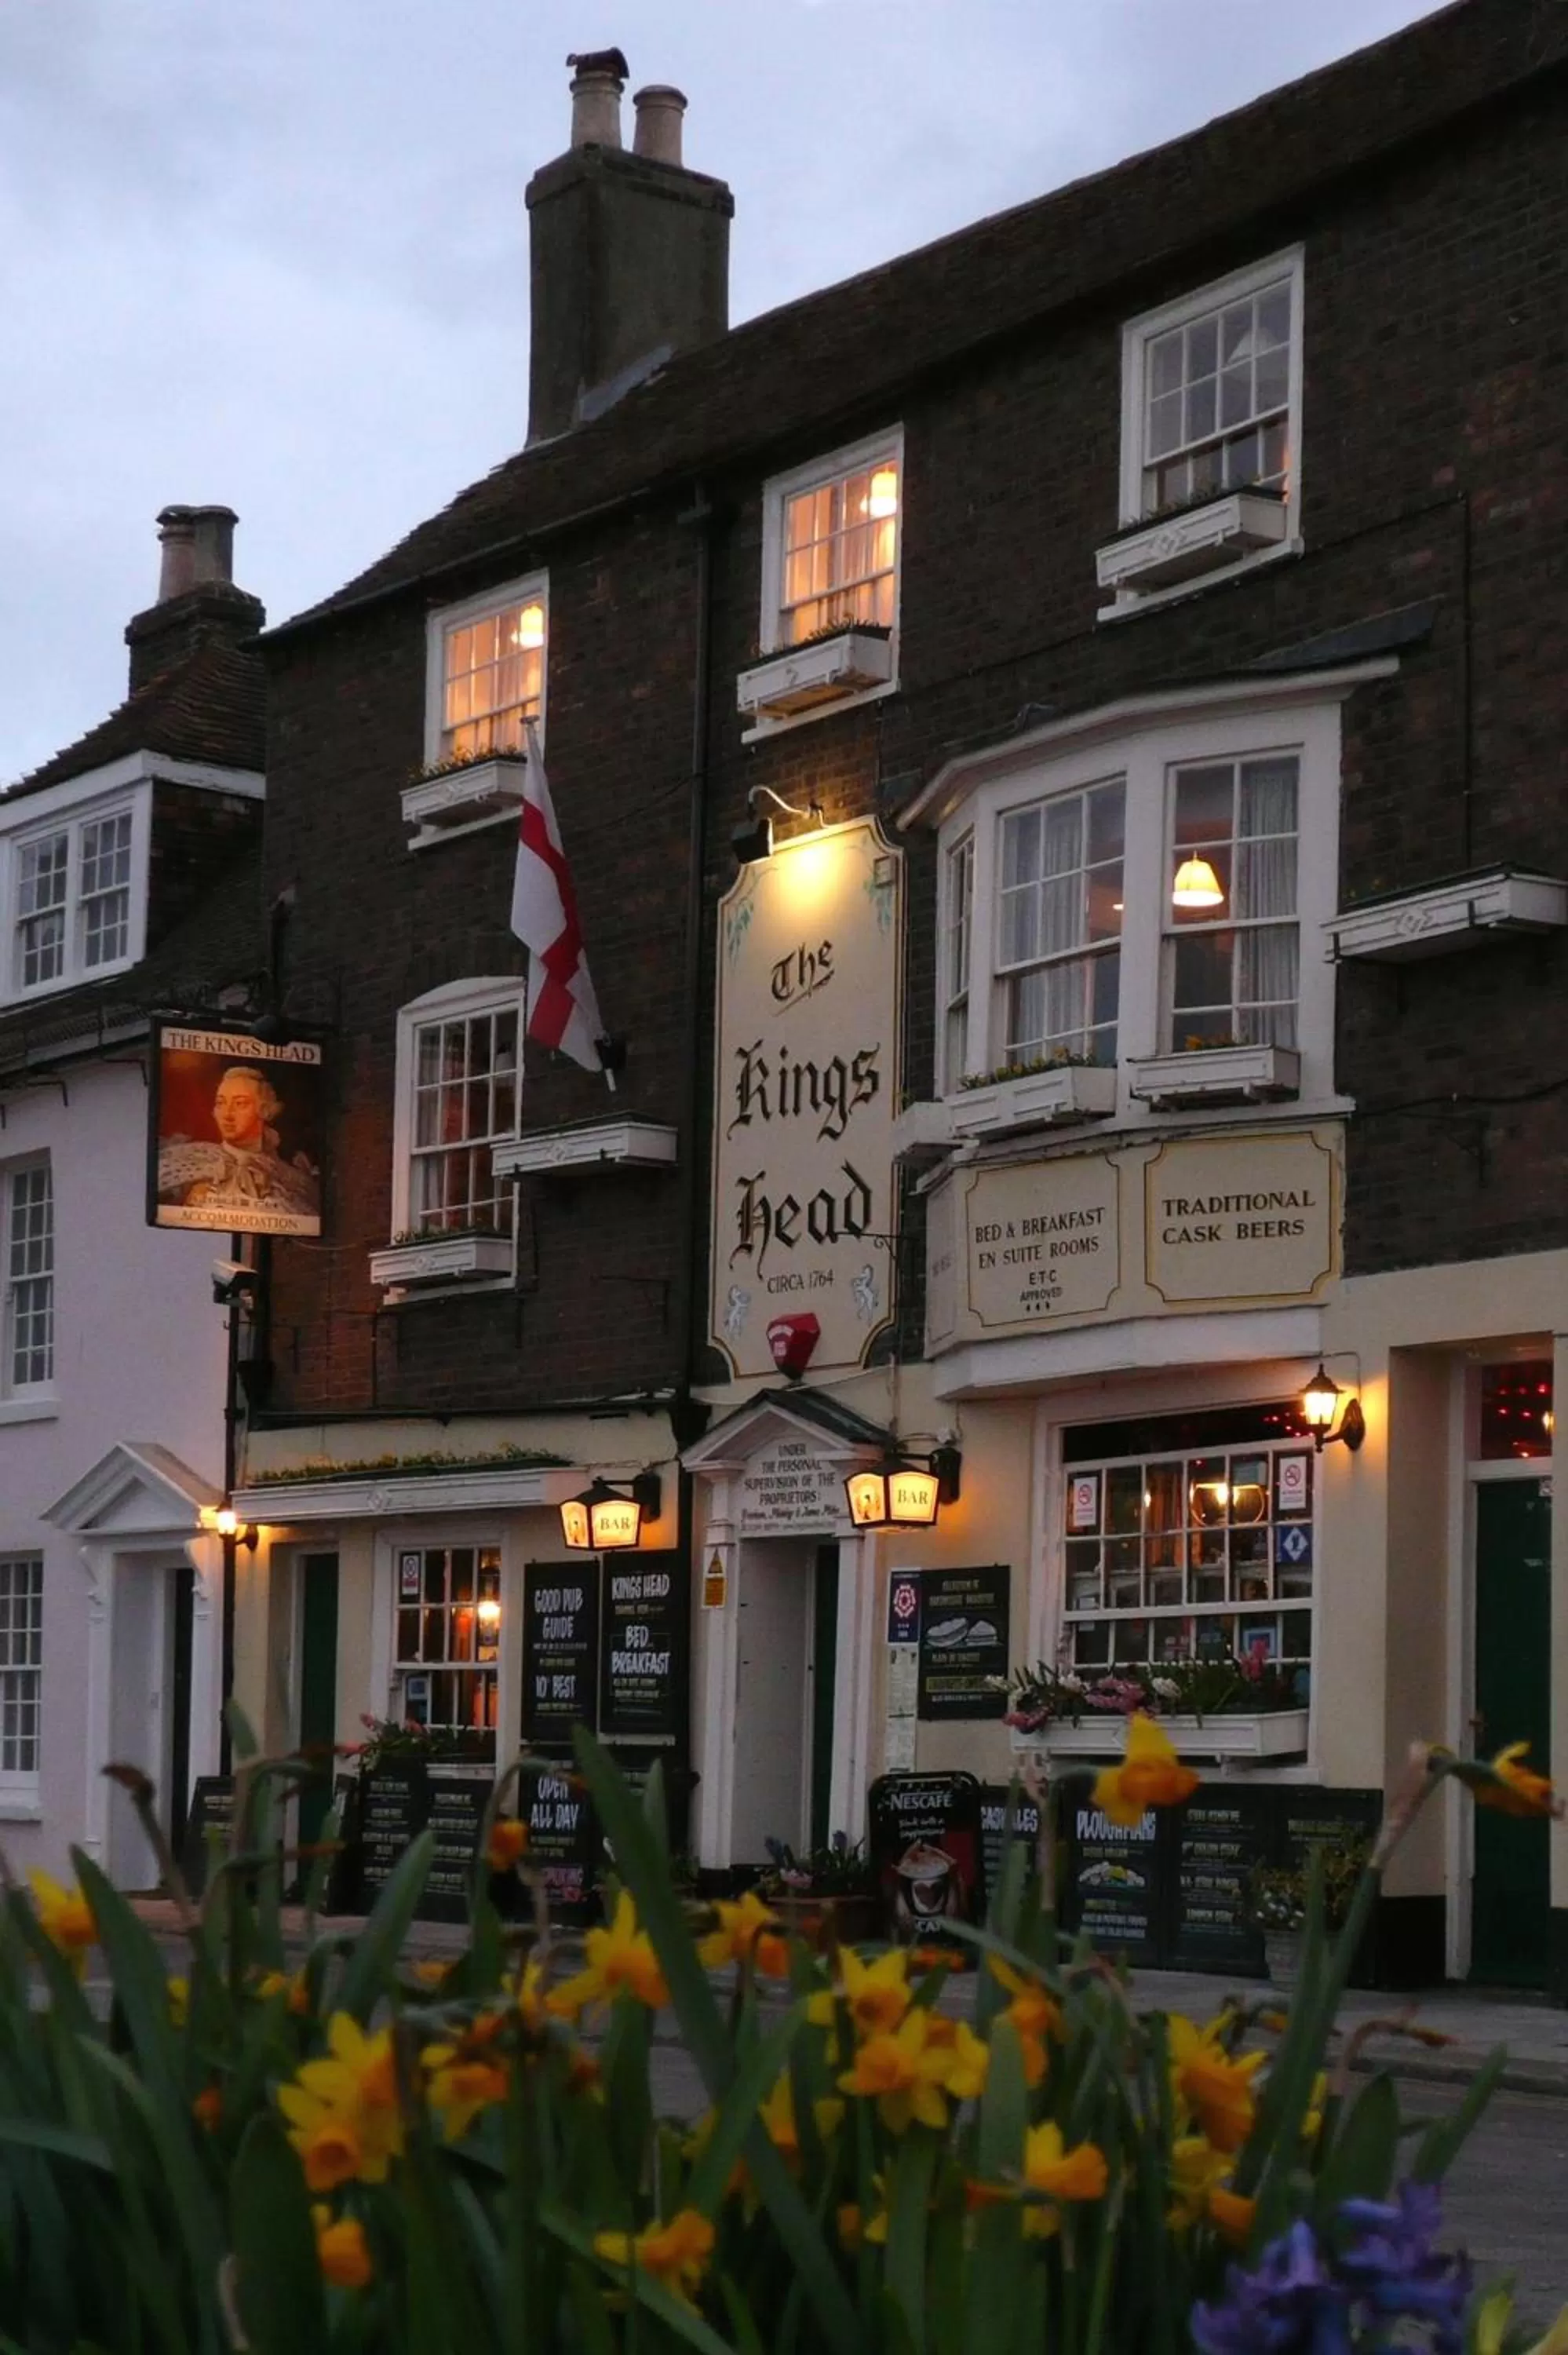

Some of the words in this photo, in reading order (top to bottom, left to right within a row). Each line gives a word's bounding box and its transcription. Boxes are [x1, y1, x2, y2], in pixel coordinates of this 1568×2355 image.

[771, 940, 834, 1005] The
[170, 1032, 202, 1050] THE
[727, 1039, 881, 1143] Kings
[1162, 1189, 1316, 1218] TRADITIONAL
[181, 1210, 298, 1230] ACCOMMODATION
[728, 1158, 873, 1280] Head
[975, 1224, 1001, 1243] BED
[1005, 1221, 1016, 1238] &
[1023, 1207, 1106, 1236] BREAKFAST
[1162, 1224, 1222, 1245] CASK
[1236, 1219, 1305, 1240] BEERS
[979, 1252, 995, 1269] EN
[1003, 1246, 1041, 1265] SUITE
[1050, 1236, 1099, 1257] ROOMS
[768, 1275, 804, 1294] CIRCA
[808, 1269, 834, 1290] 1764
[1020, 1287, 1062, 1303] APPROVED
[779, 1444, 806, 1457] UNDER
[778, 1459, 822, 1472] PERSONAL
[744, 1477, 798, 1490] SUPERVISION
[802, 1474, 812, 1487] OF
[819, 1472, 835, 1486] THE
[897, 1488, 929, 1505] BAR
[600, 1516, 631, 1532] BAR
[611, 1576, 641, 1601] KINGS
[644, 1573, 670, 1598] HEAD
[534, 1590, 561, 1614] GOOD
[563, 1588, 583, 1612] PUB
[542, 1616, 574, 1640] GUIDE
[625, 1625, 649, 1648] BED
[611, 1652, 670, 1674] BREAKFAST
[552, 1674, 576, 1699] BEST
[890, 1791, 954, 1810] NESCAFÉ
[531, 1803, 553, 1830] ALL
[555, 1802, 579, 1831] DAY
